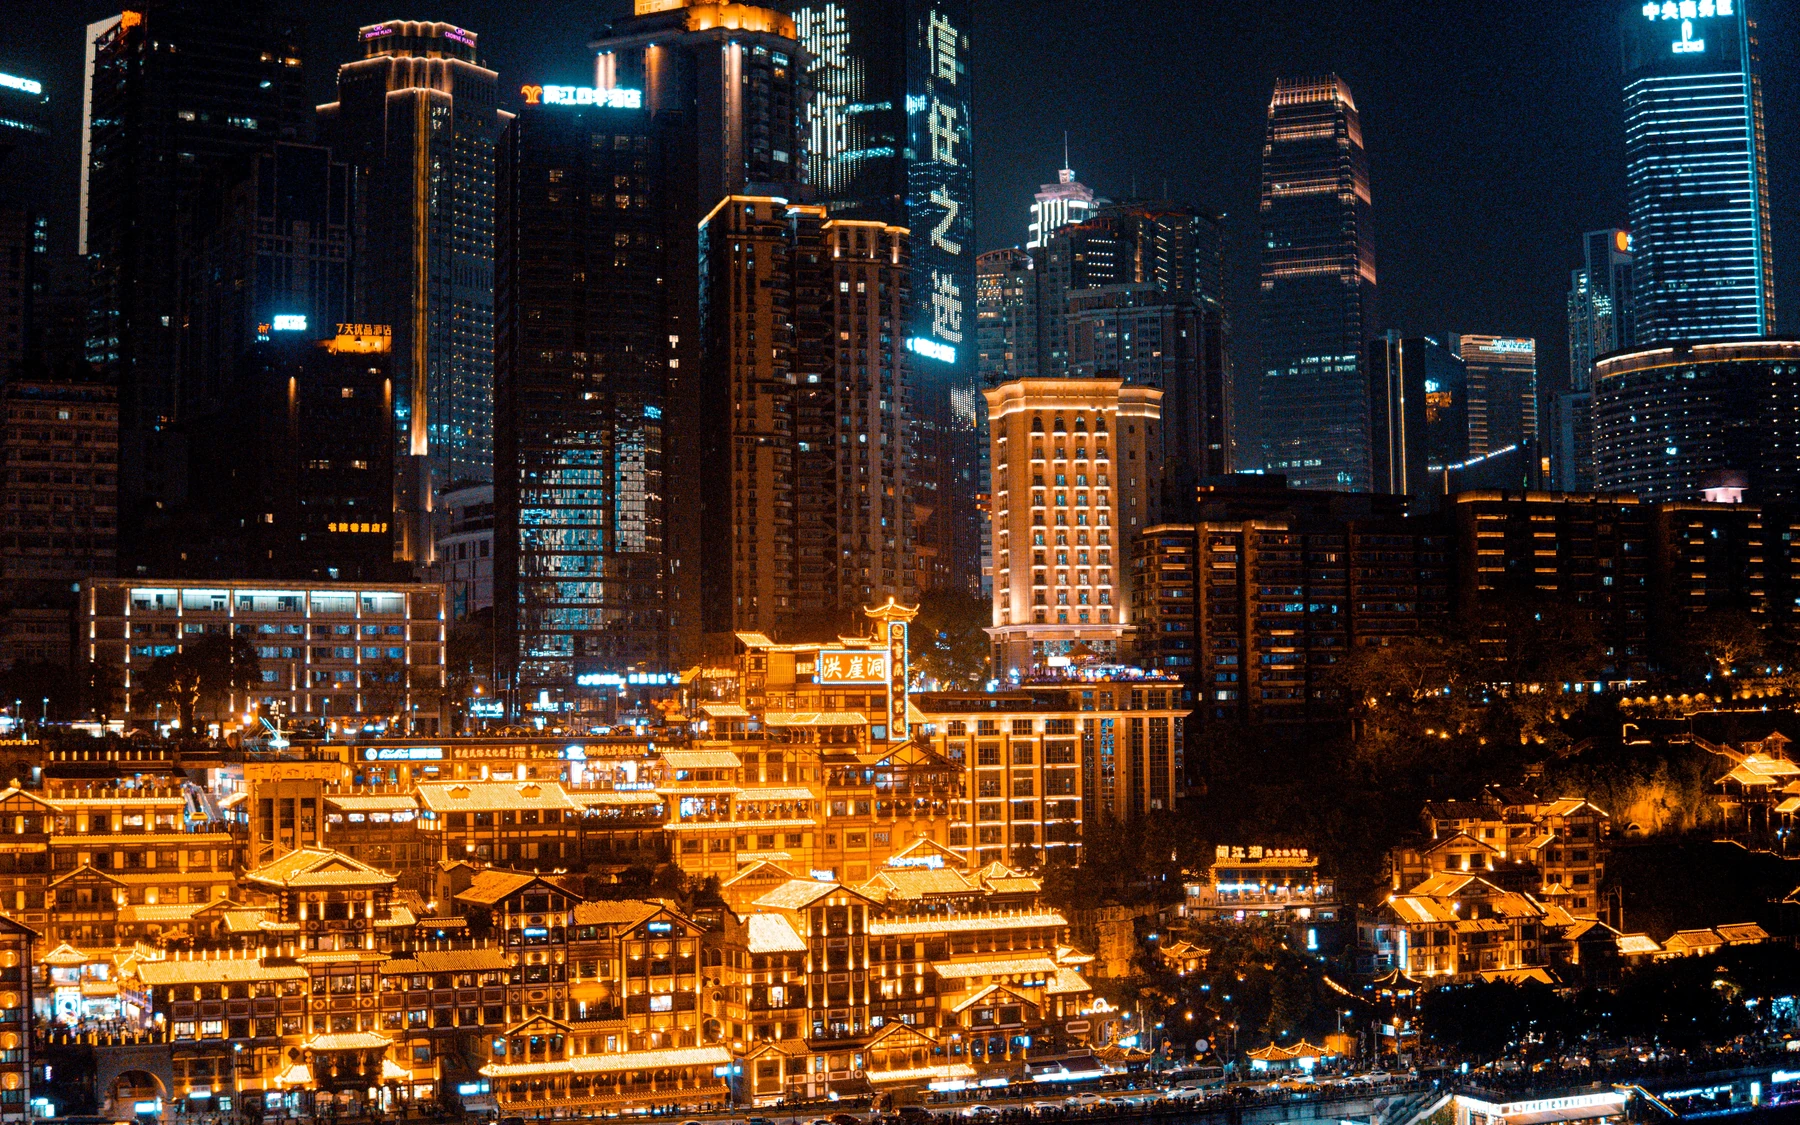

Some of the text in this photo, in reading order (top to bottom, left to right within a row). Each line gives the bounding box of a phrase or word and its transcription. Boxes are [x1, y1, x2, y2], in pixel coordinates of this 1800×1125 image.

[1642, 0, 1734, 21] 中央商务区
[461, 36, 475, 47] PLAZA
[336, 323, 392, 336] 7天优品酒店
[823, 655, 885, 679] 洪崖洞
[1215, 845, 1263, 858] 闹江湖
